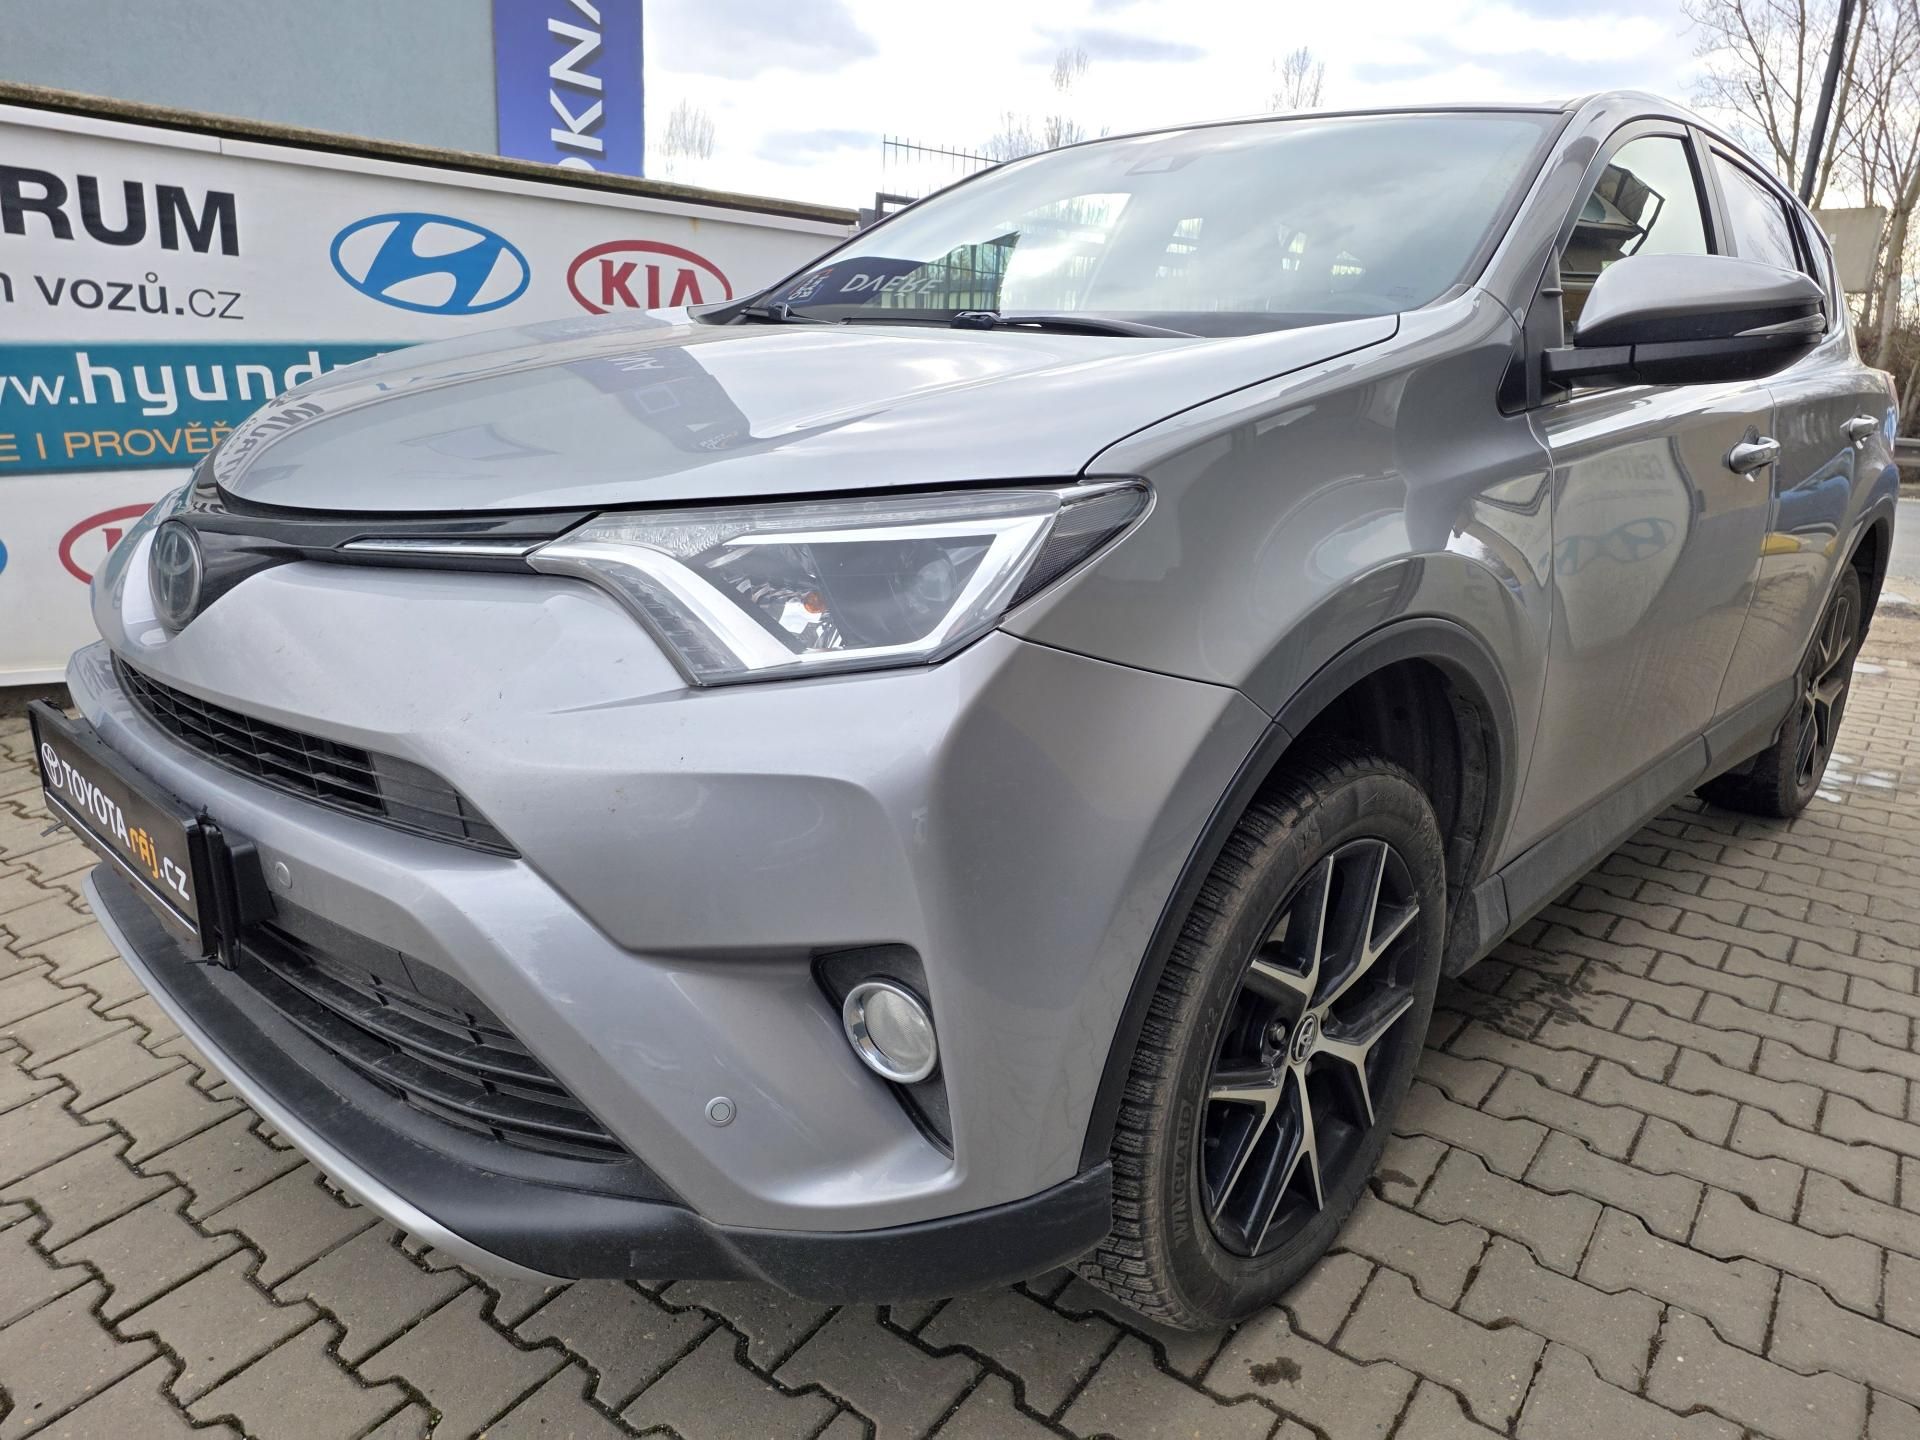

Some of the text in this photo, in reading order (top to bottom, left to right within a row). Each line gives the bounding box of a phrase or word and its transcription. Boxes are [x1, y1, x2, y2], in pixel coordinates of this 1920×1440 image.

[0, 164, 240, 257] RUM
[34, 272, 244, 319] vozů.cz
[599, 259, 704, 309] KIA
